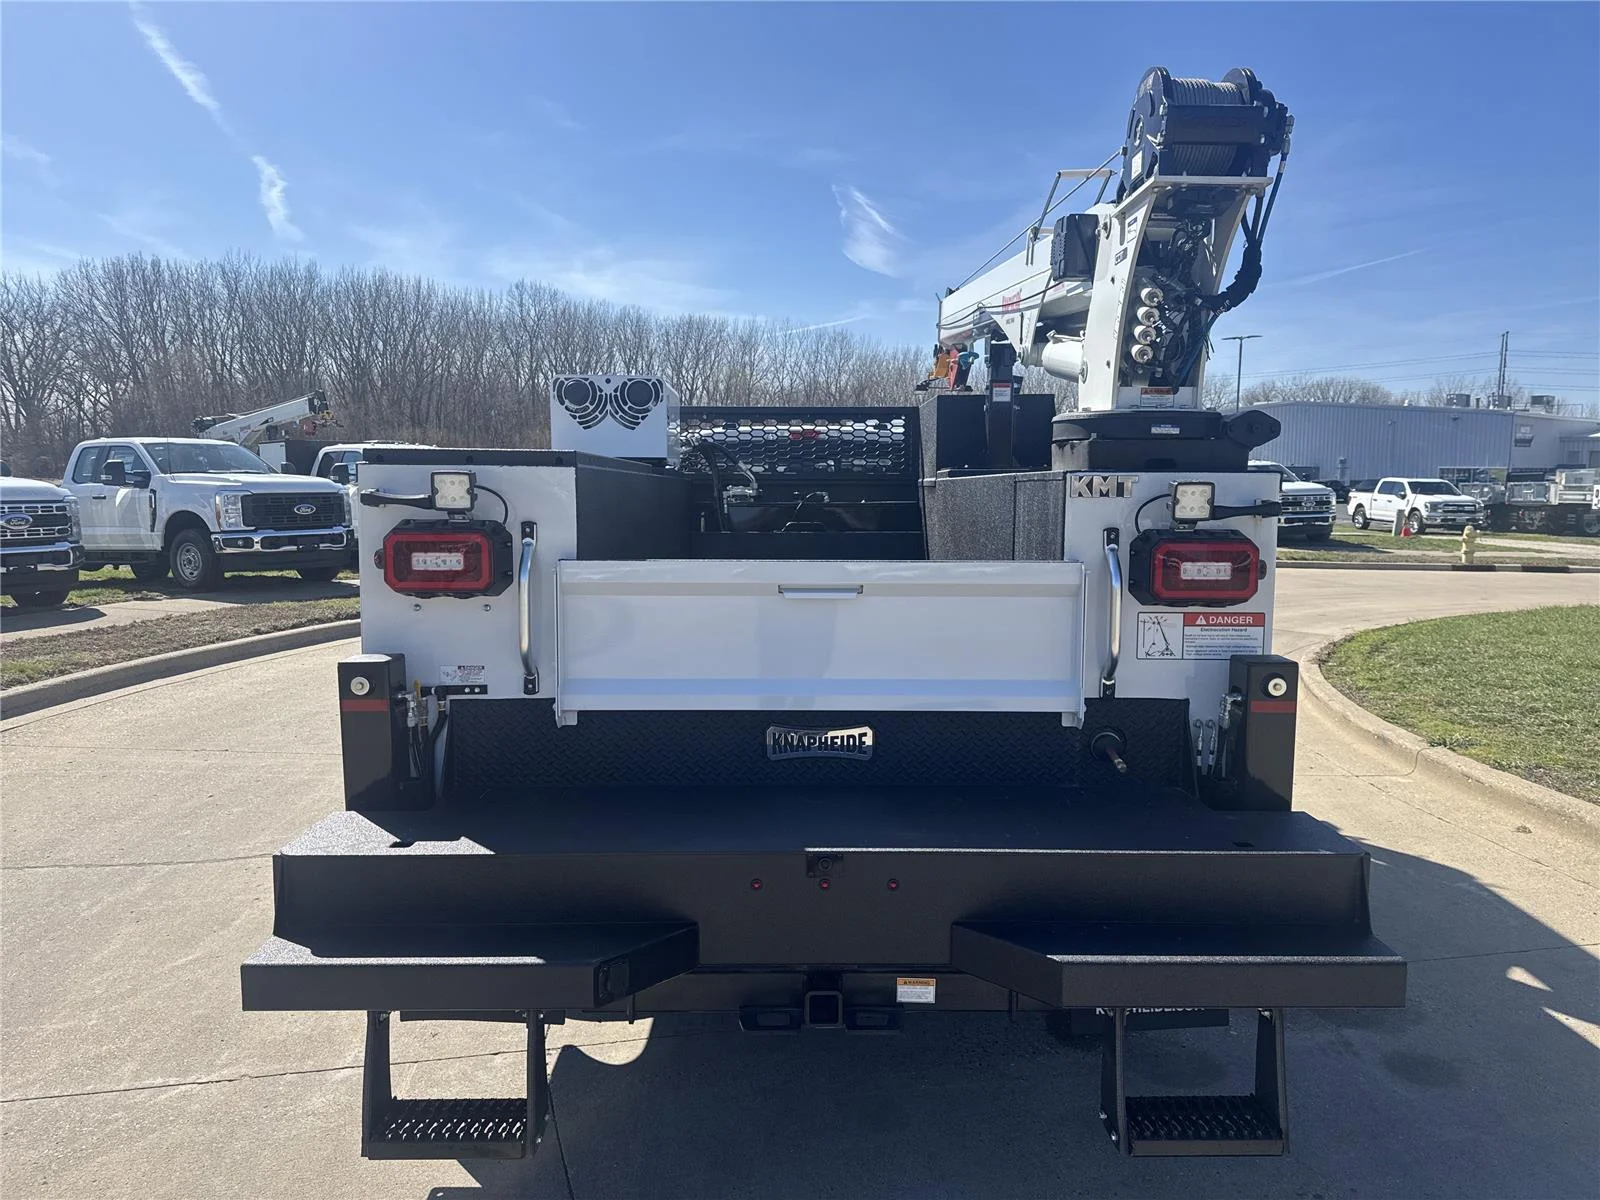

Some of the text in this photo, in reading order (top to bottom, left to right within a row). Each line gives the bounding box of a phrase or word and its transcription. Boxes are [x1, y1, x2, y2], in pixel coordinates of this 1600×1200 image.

[1070, 475, 1139, 498] KMT
[1209, 615, 1253, 624] DANGER
[771, 732, 868, 755] KNAPHEIDE
